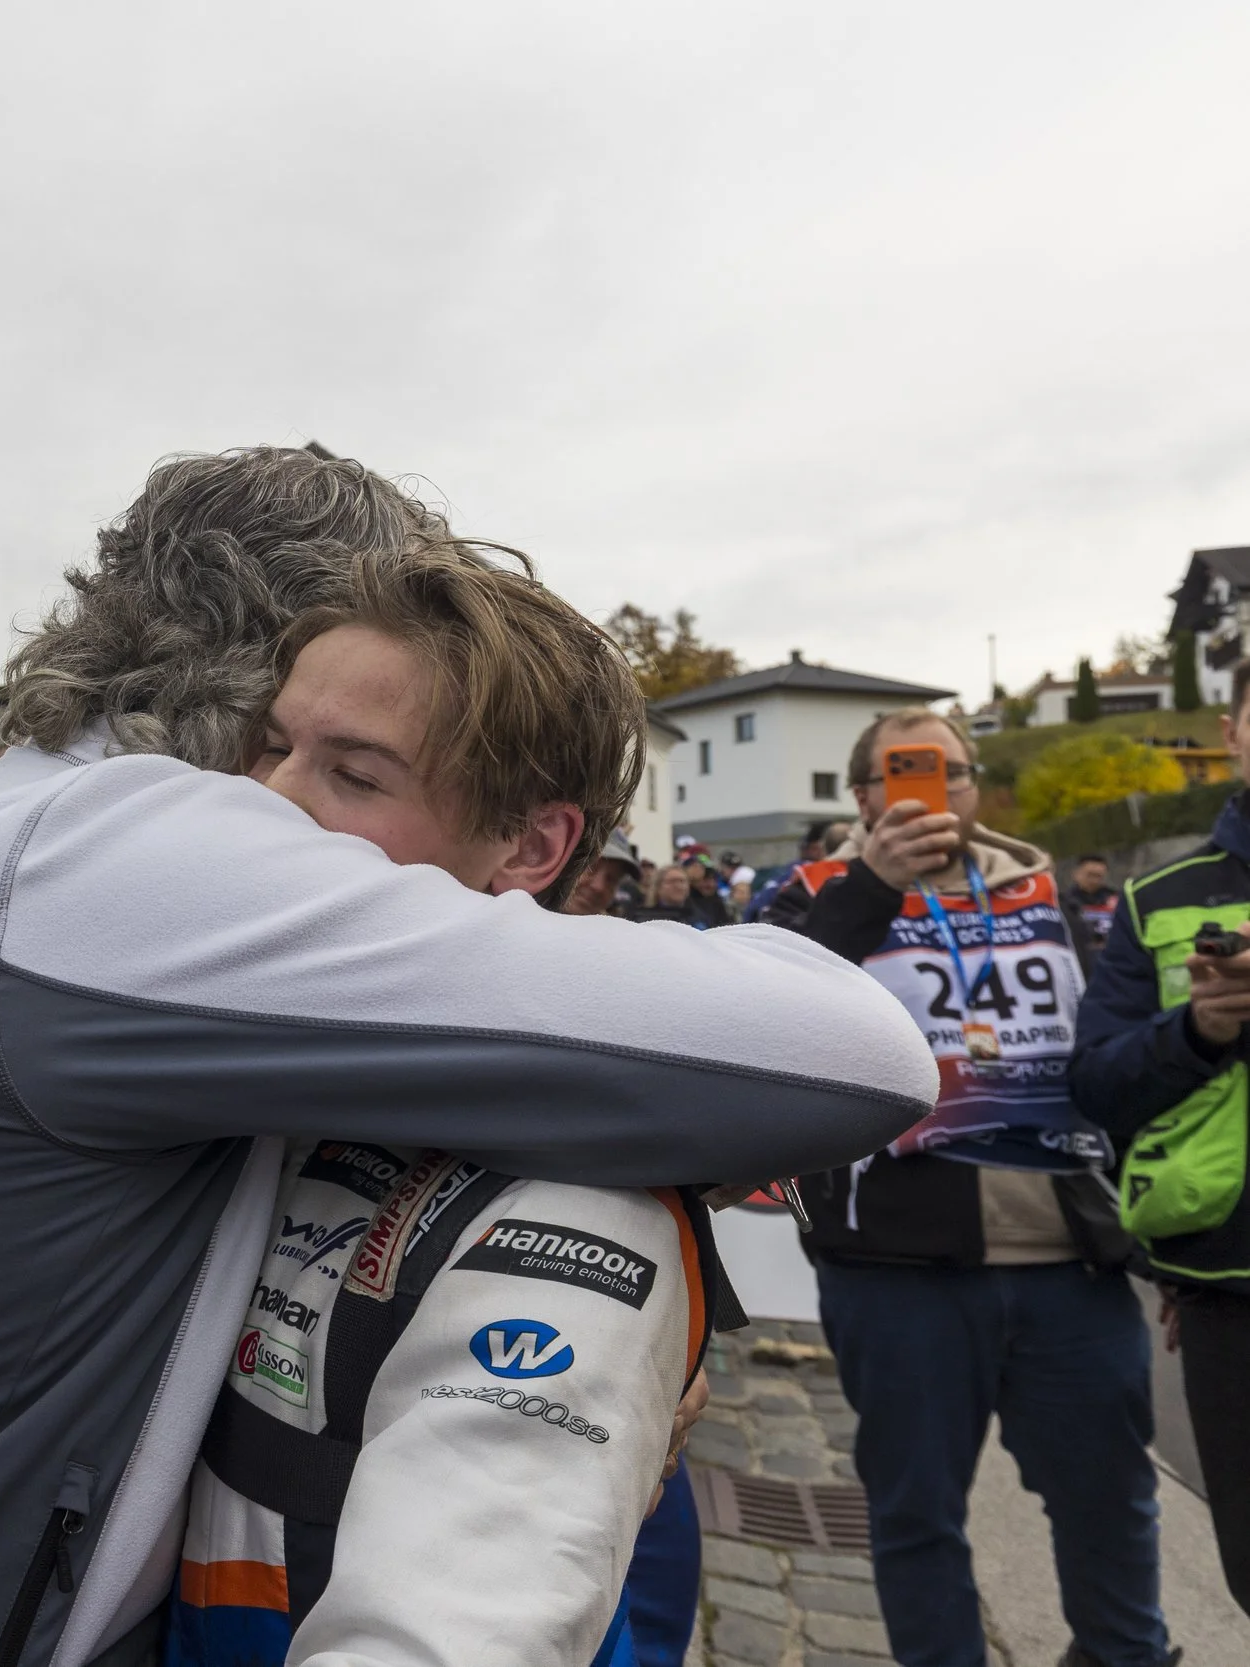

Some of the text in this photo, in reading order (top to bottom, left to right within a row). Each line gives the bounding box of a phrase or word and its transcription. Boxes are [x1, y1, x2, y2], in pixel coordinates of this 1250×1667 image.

[914, 956, 1059, 1021] 249
[357, 1147, 450, 1280] SIMPSON
[520, 1255, 638, 1297] driving emotion
